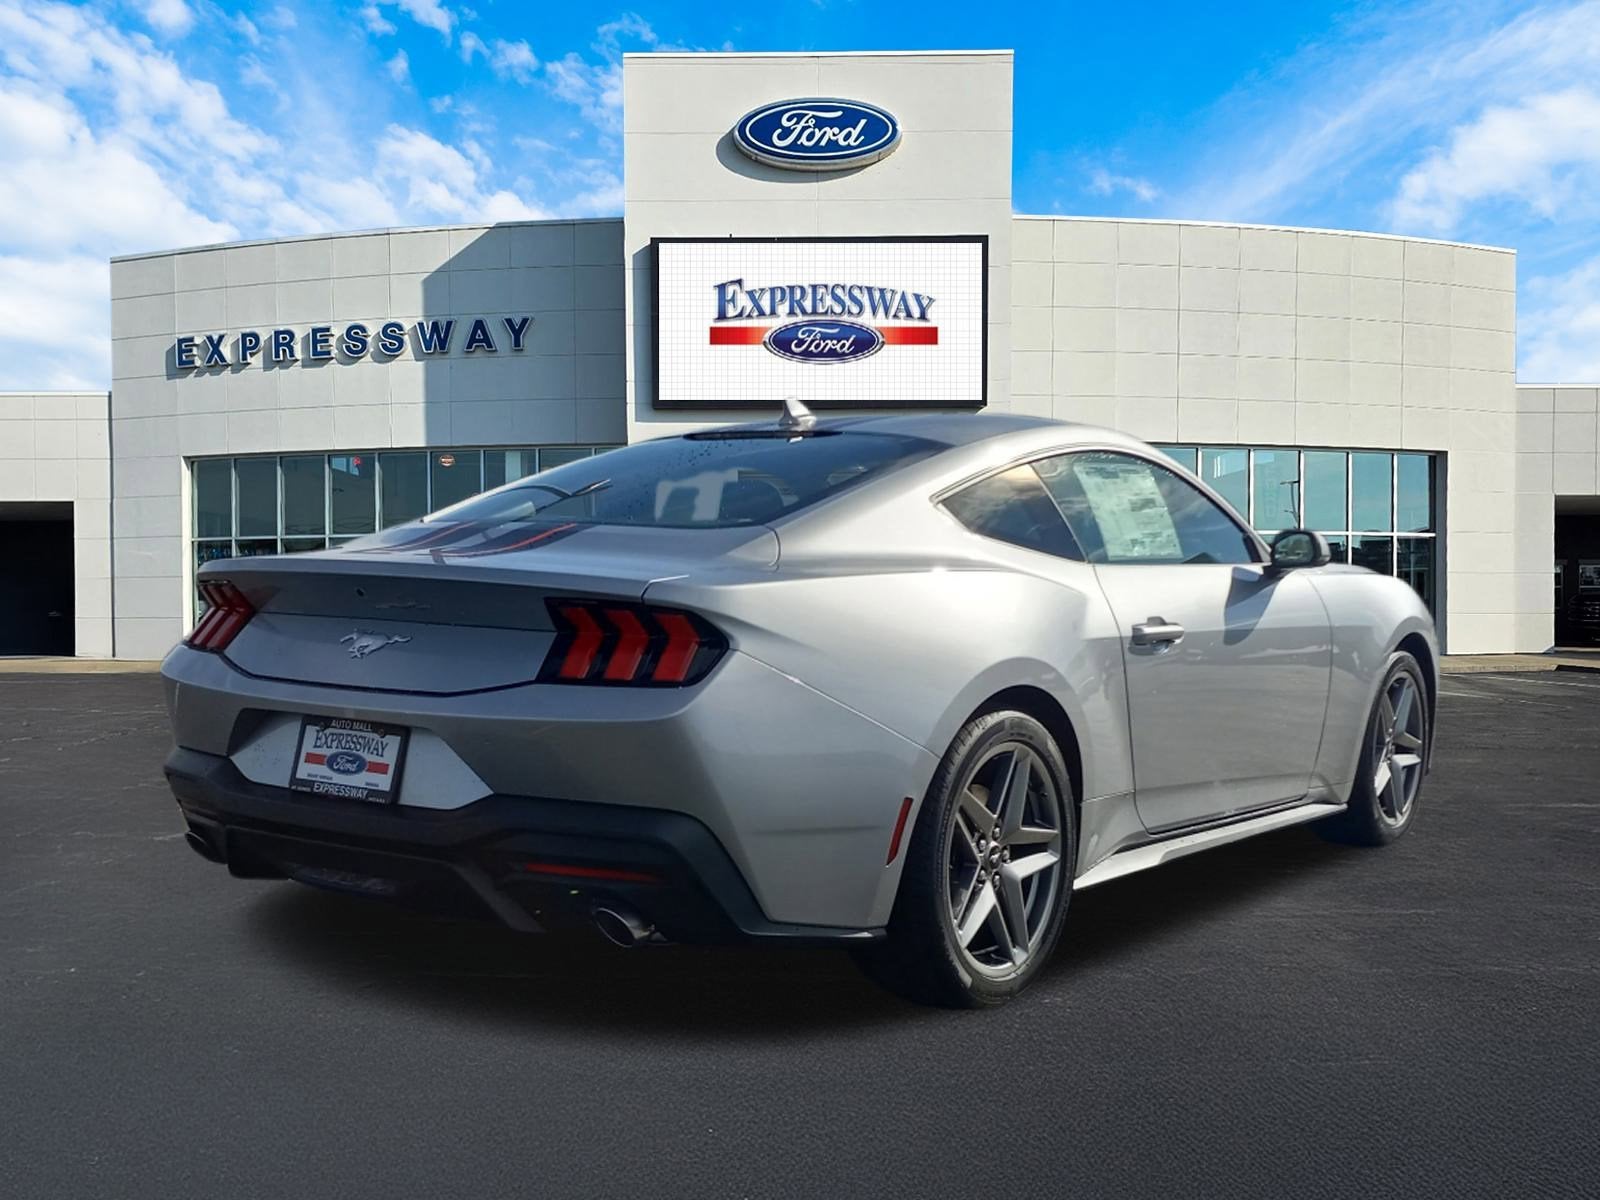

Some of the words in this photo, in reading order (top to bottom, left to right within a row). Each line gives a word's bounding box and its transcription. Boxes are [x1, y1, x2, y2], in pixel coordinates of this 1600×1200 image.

[772, 110, 868, 147] Ford
[713, 278, 936, 322] EXPRESSWAY
[175, 316, 532, 369] EXPRESSWAY
[790, 326, 855, 354] Ford
[331, 719, 352, 729] AUTO
[352, 721, 372, 731] MALL
[313, 729, 389, 758] EXPRESSWAY
[333, 755, 360, 772] Ford
[313, 782, 368, 799] EXPRESSWAY
